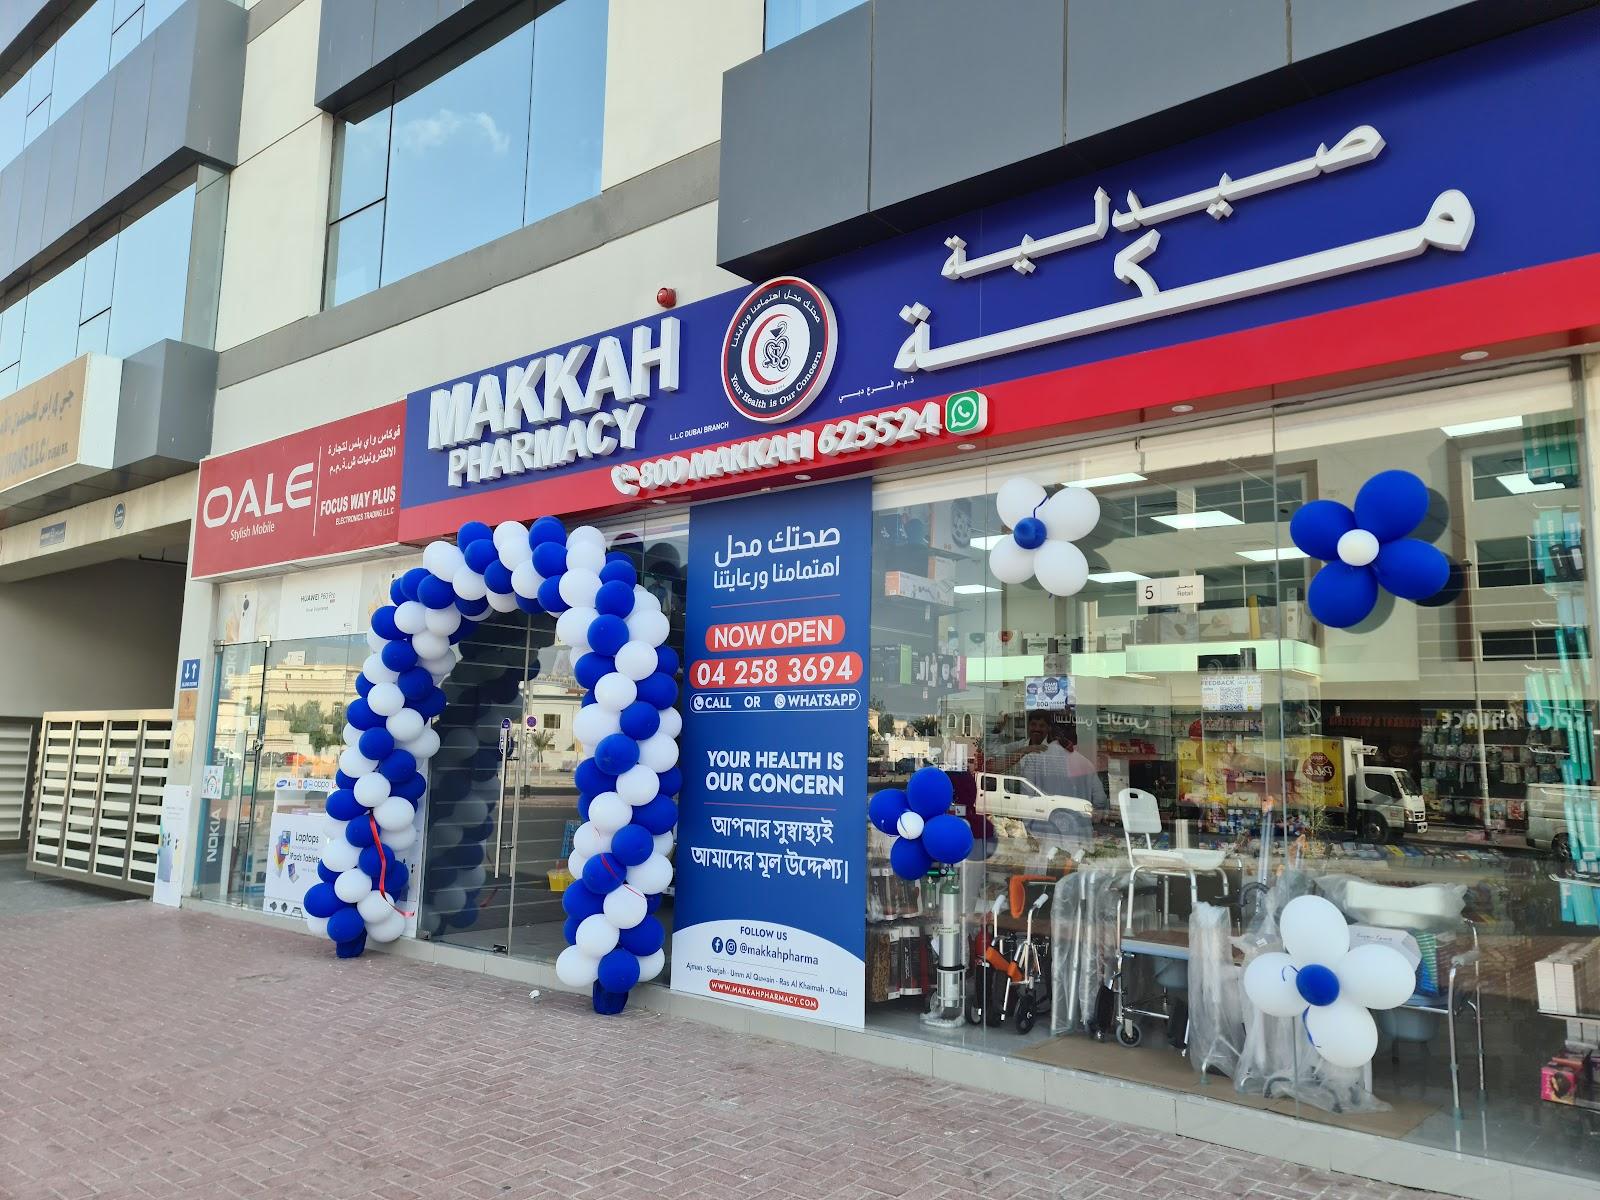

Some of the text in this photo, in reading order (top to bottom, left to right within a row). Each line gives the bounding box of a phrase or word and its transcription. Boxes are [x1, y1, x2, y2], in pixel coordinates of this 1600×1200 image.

[940, 124, 1386, 280] صيدلية
[892, 188, 1475, 373] مكة
[750, 289, 780, 314] اهتمامنا
[783, 289, 802, 302] محل
[803, 300, 820, 323] صحتك
[428, 316, 681, 451] MAKKAH
[730, 350, 822, 409] Your Health is Our Concern
[838, 388, 864, 404] دبي
[684, 426, 703, 438] DUBAI
[703, 421, 729, 433] BRANCH
[447, 402, 646, 487] PHARMACY
[638, 400, 943, 491] 800 MAKKAH 625524
[203, 462, 314, 529] OALE
[320, 485, 396, 516] FOCUS WAY PLUS
[335, 513, 364, 526] ELECTRONICS
[364, 509, 382, 520] TRADING
[230, 520, 275, 542] Stylish Mobile
[714, 525, 841, 568] صحتك محل
[713, 555, 840, 592] اهتمامنا ورعايتنا
[1145, 585, 1154, 600] 5
[714, 618, 833, 649] NOW OPEN
[697, 655, 853, 686] 04 258 3694
[704, 693, 857, 709] CALL OR WHATSAPP
[707, 750, 844, 771] YOUR HEALTH IS
[705, 772, 844, 796] OUR CONCERN
[207, 807, 221, 863] NOKIA
[295, 832, 319, 844] Laptops
[710, 816, 771, 840] আপনার
[690, 846, 754, 872] আমাদের
[756, 852, 782, 879] মূল
[740, 926, 788, 941] FOLLOW US
[739, 942, 819, 966] @makkahpharma
[685, 962, 848, 997] Ajman Sharjah Umm Al Quwain Ras Al Khaimah Dubai
[711, 982, 817, 1008] WWW.MAKKAHPHARMACY.COM
